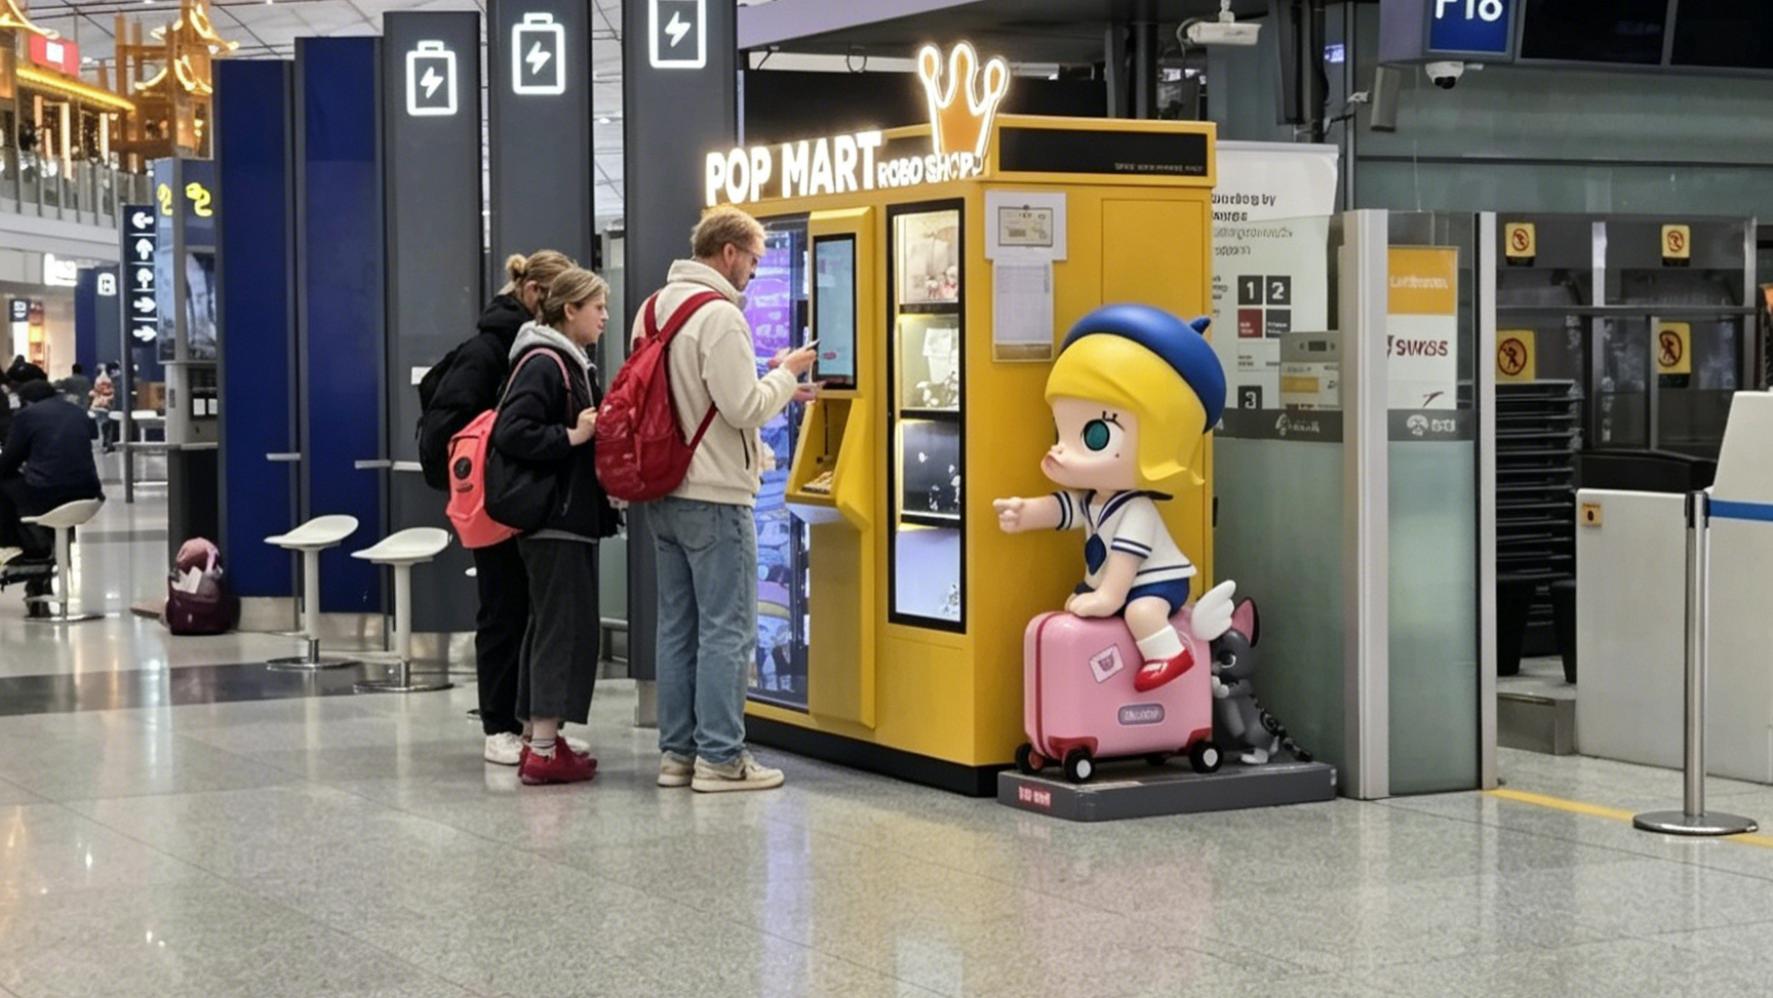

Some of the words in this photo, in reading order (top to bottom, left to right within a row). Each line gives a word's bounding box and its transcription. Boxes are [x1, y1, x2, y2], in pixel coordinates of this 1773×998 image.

[705, 146, 772, 206] POP
[781, 130, 882, 198] MART
[878, 156, 924, 188] ROBO
[1246, 281, 1255, 300] 1
[1271, 281, 1285, 300] 2
[1244, 391, 1257, 409] 3
